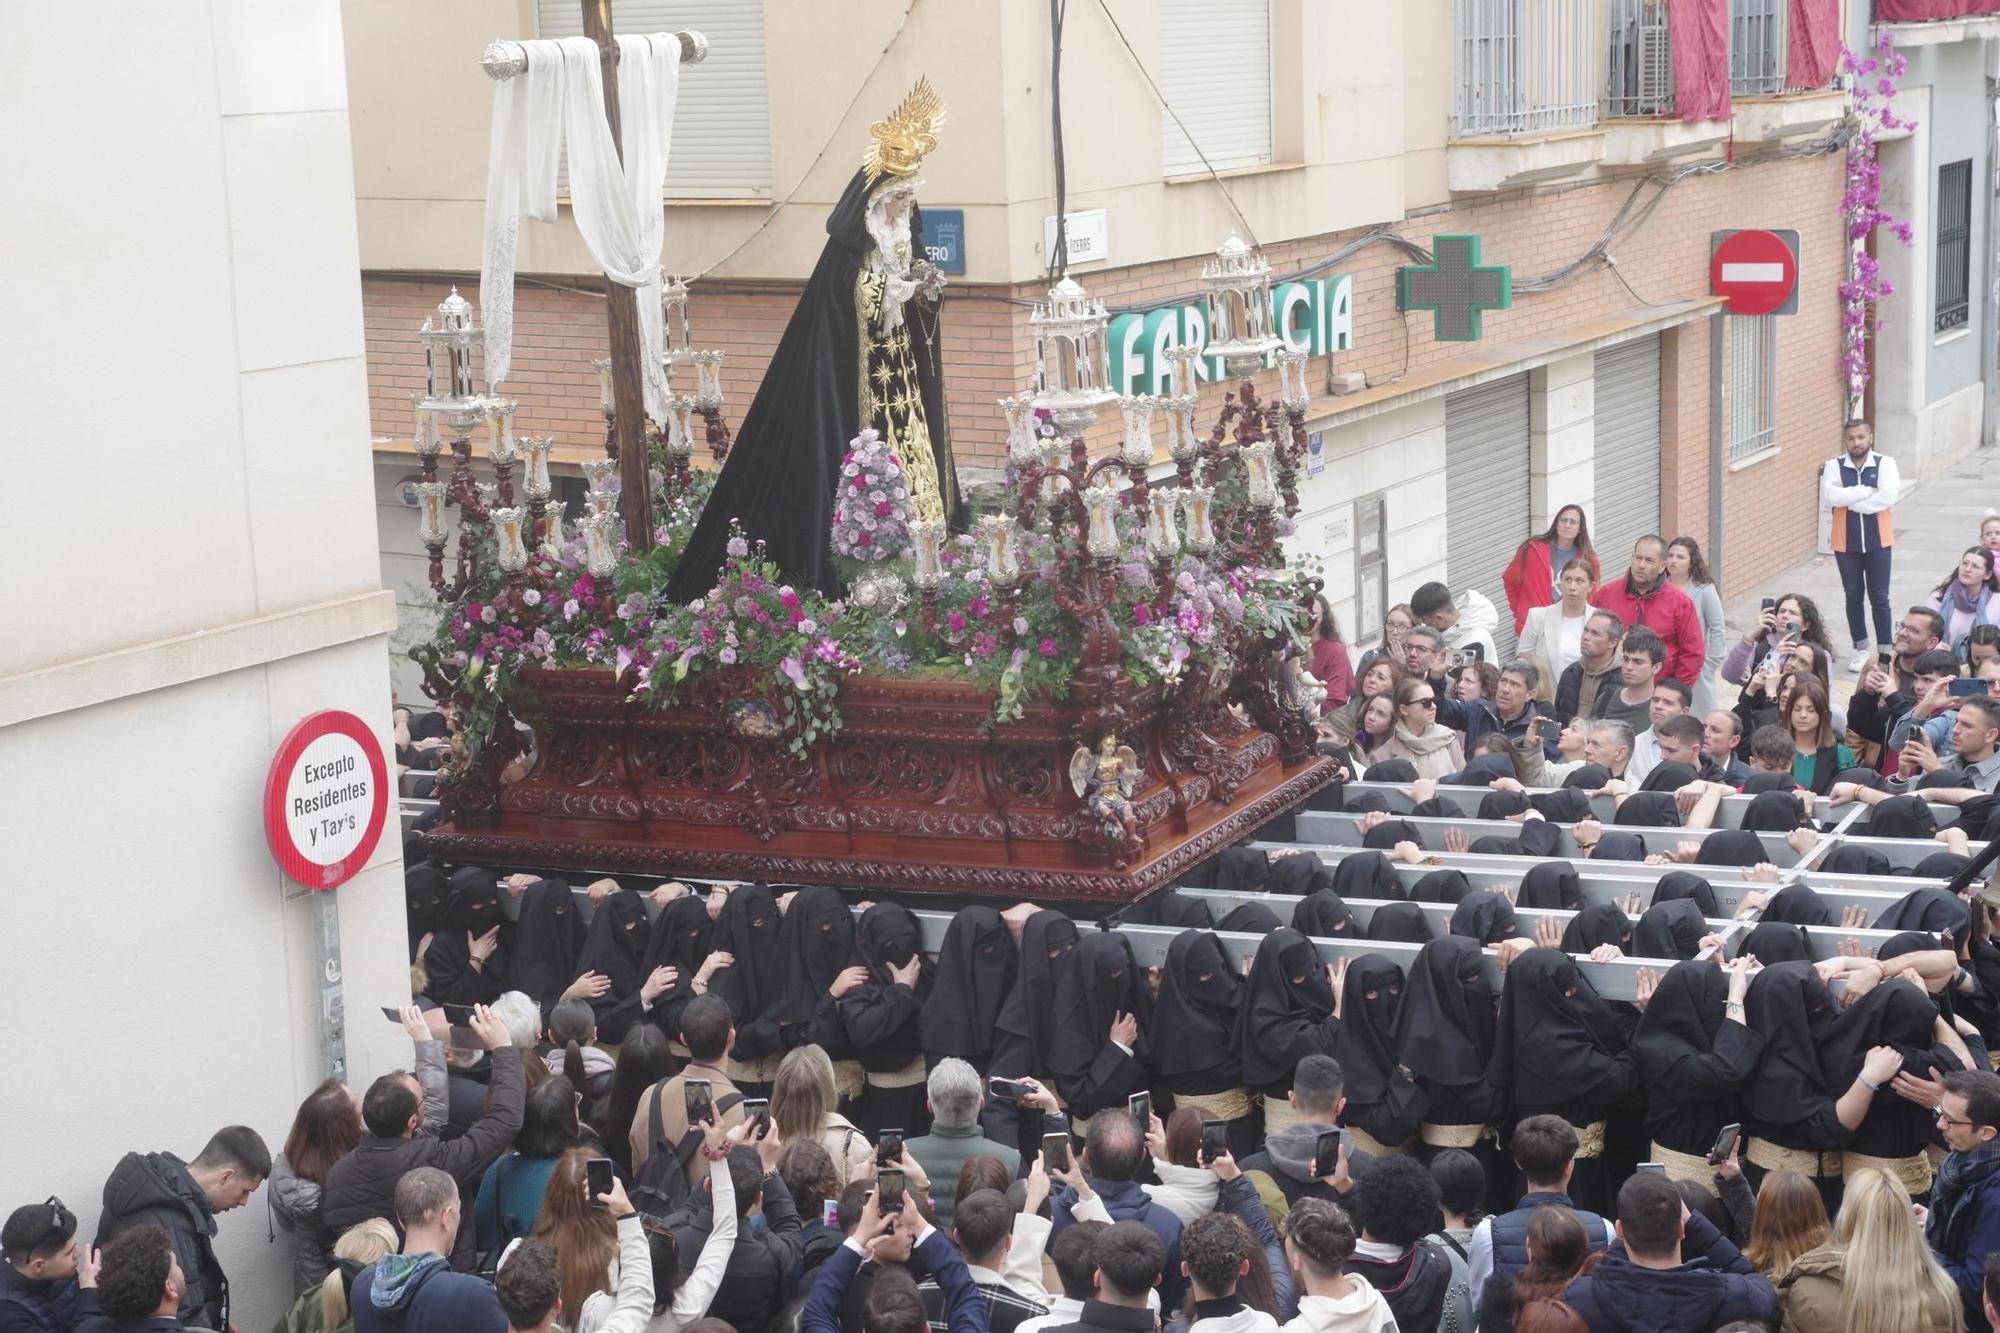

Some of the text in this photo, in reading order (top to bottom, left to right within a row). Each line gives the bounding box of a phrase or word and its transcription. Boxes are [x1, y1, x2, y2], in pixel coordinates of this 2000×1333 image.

[925, 246, 948, 261] ERO
[305, 754, 355, 784] Excepto
[294, 781, 366, 817] Residentes
[310, 827, 317, 846] y
